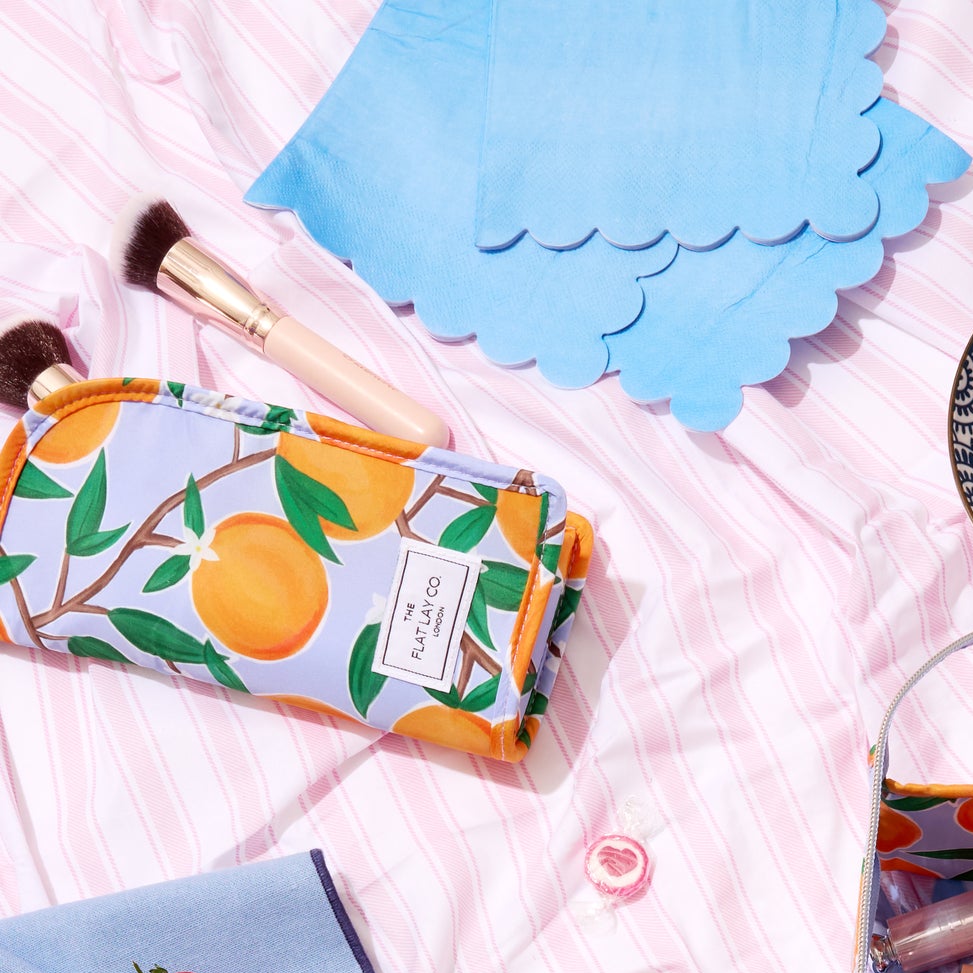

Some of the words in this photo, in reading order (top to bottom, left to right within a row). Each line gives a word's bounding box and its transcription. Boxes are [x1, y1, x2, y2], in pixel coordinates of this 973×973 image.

[426, 575, 442, 598] CO.
[403, 602, 416, 622] THE
[419, 601, 435, 627] LAY
[432, 606, 446, 638] LONDON
[411, 626, 427, 661] FLAT
